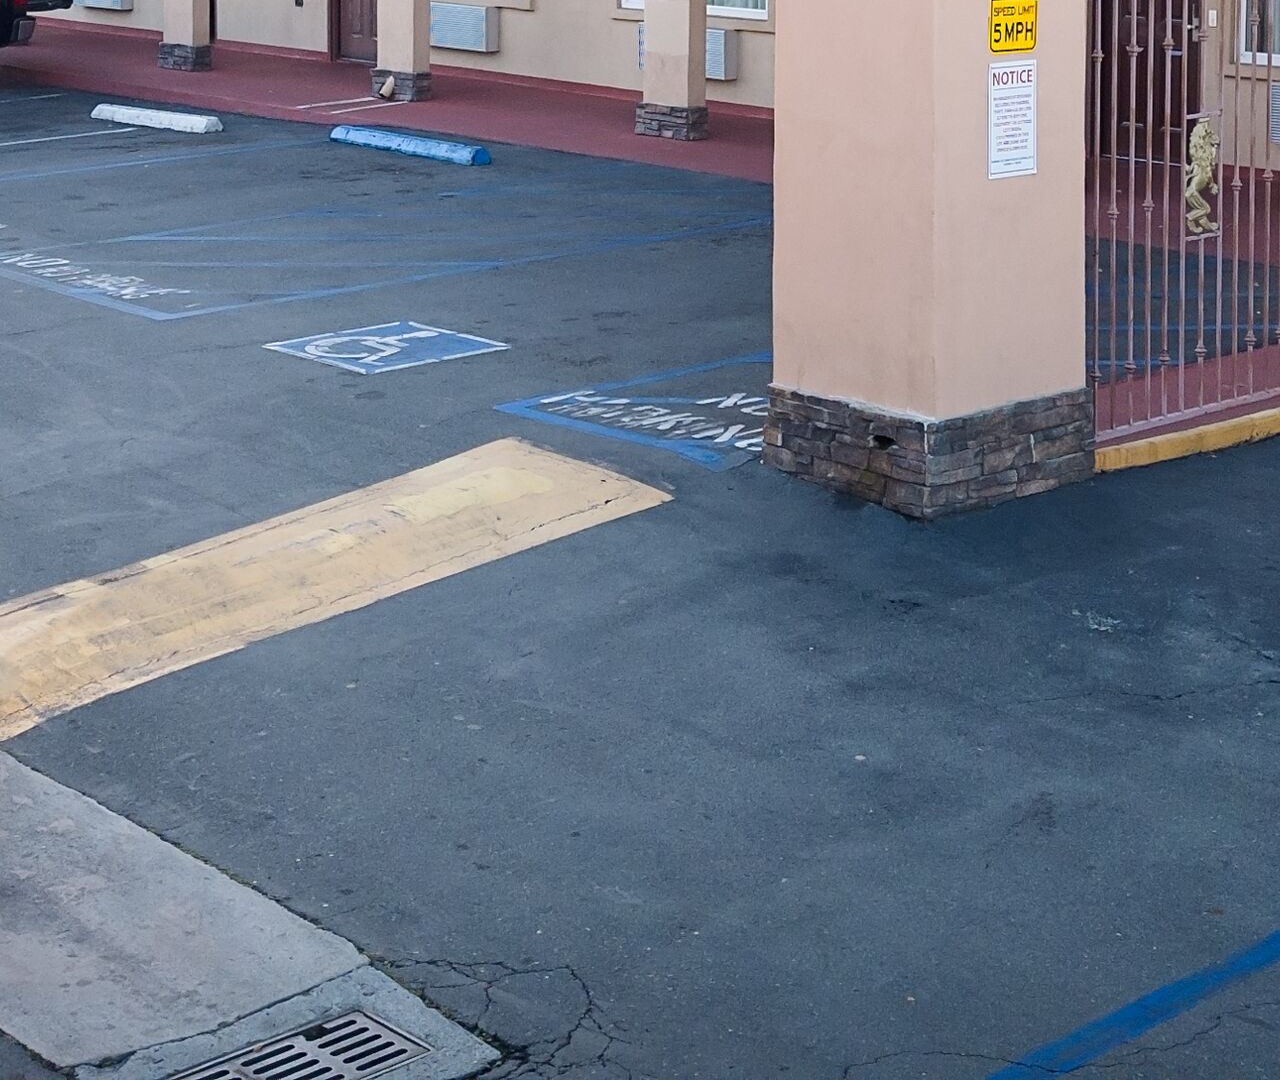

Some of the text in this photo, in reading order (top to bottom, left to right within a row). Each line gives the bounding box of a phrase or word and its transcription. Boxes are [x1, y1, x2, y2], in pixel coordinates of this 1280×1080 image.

[993, 5, 1035, 17] SPEED LIMIT
[993, 21, 1034, 43] 5 MPH
[992, 69, 1033, 87] NOTICE
